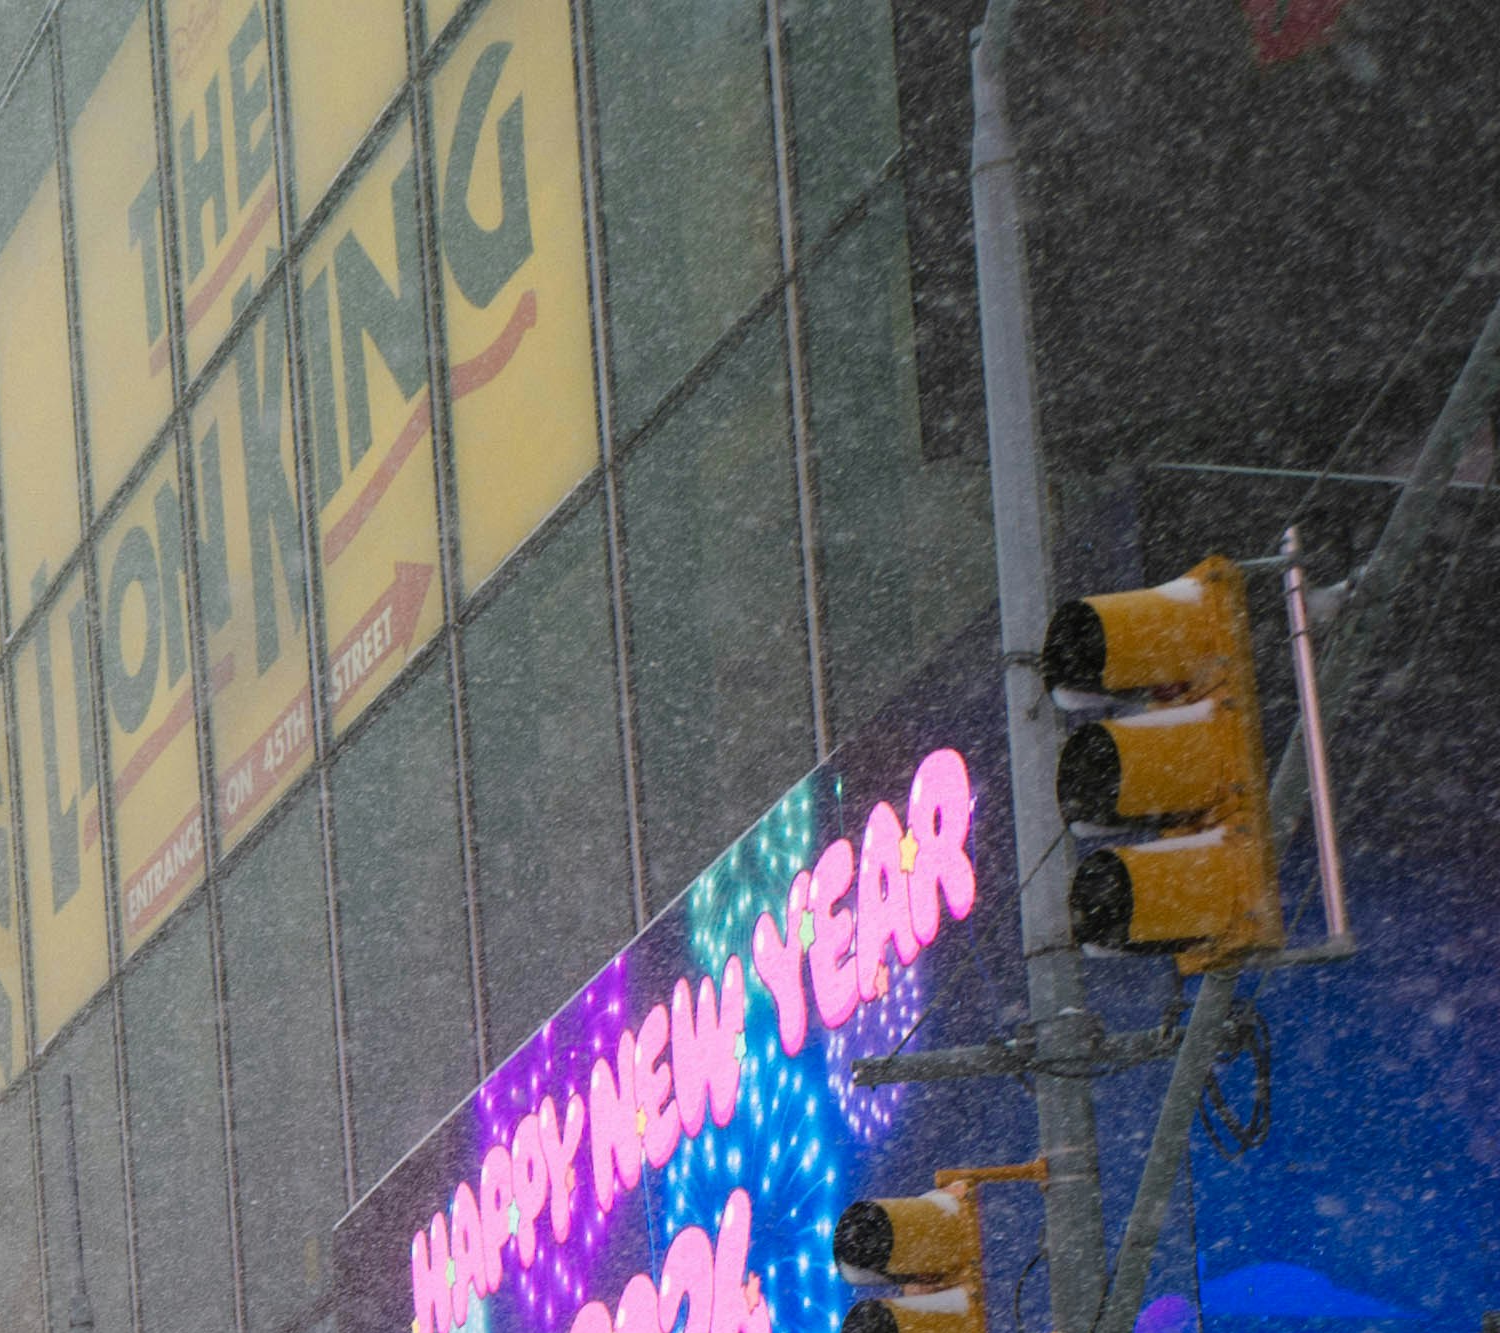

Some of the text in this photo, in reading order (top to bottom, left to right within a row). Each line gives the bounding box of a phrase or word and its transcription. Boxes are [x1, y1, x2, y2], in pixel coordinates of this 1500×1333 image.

[128, 8, 274, 344] THE
[230, 41, 536, 678] KING
[126, 608, 394, 918] ENTRANCE ON 45TH STREET
[590, 954, 748, 1213] NEW
[752, 747, 977, 1058] YEAR
